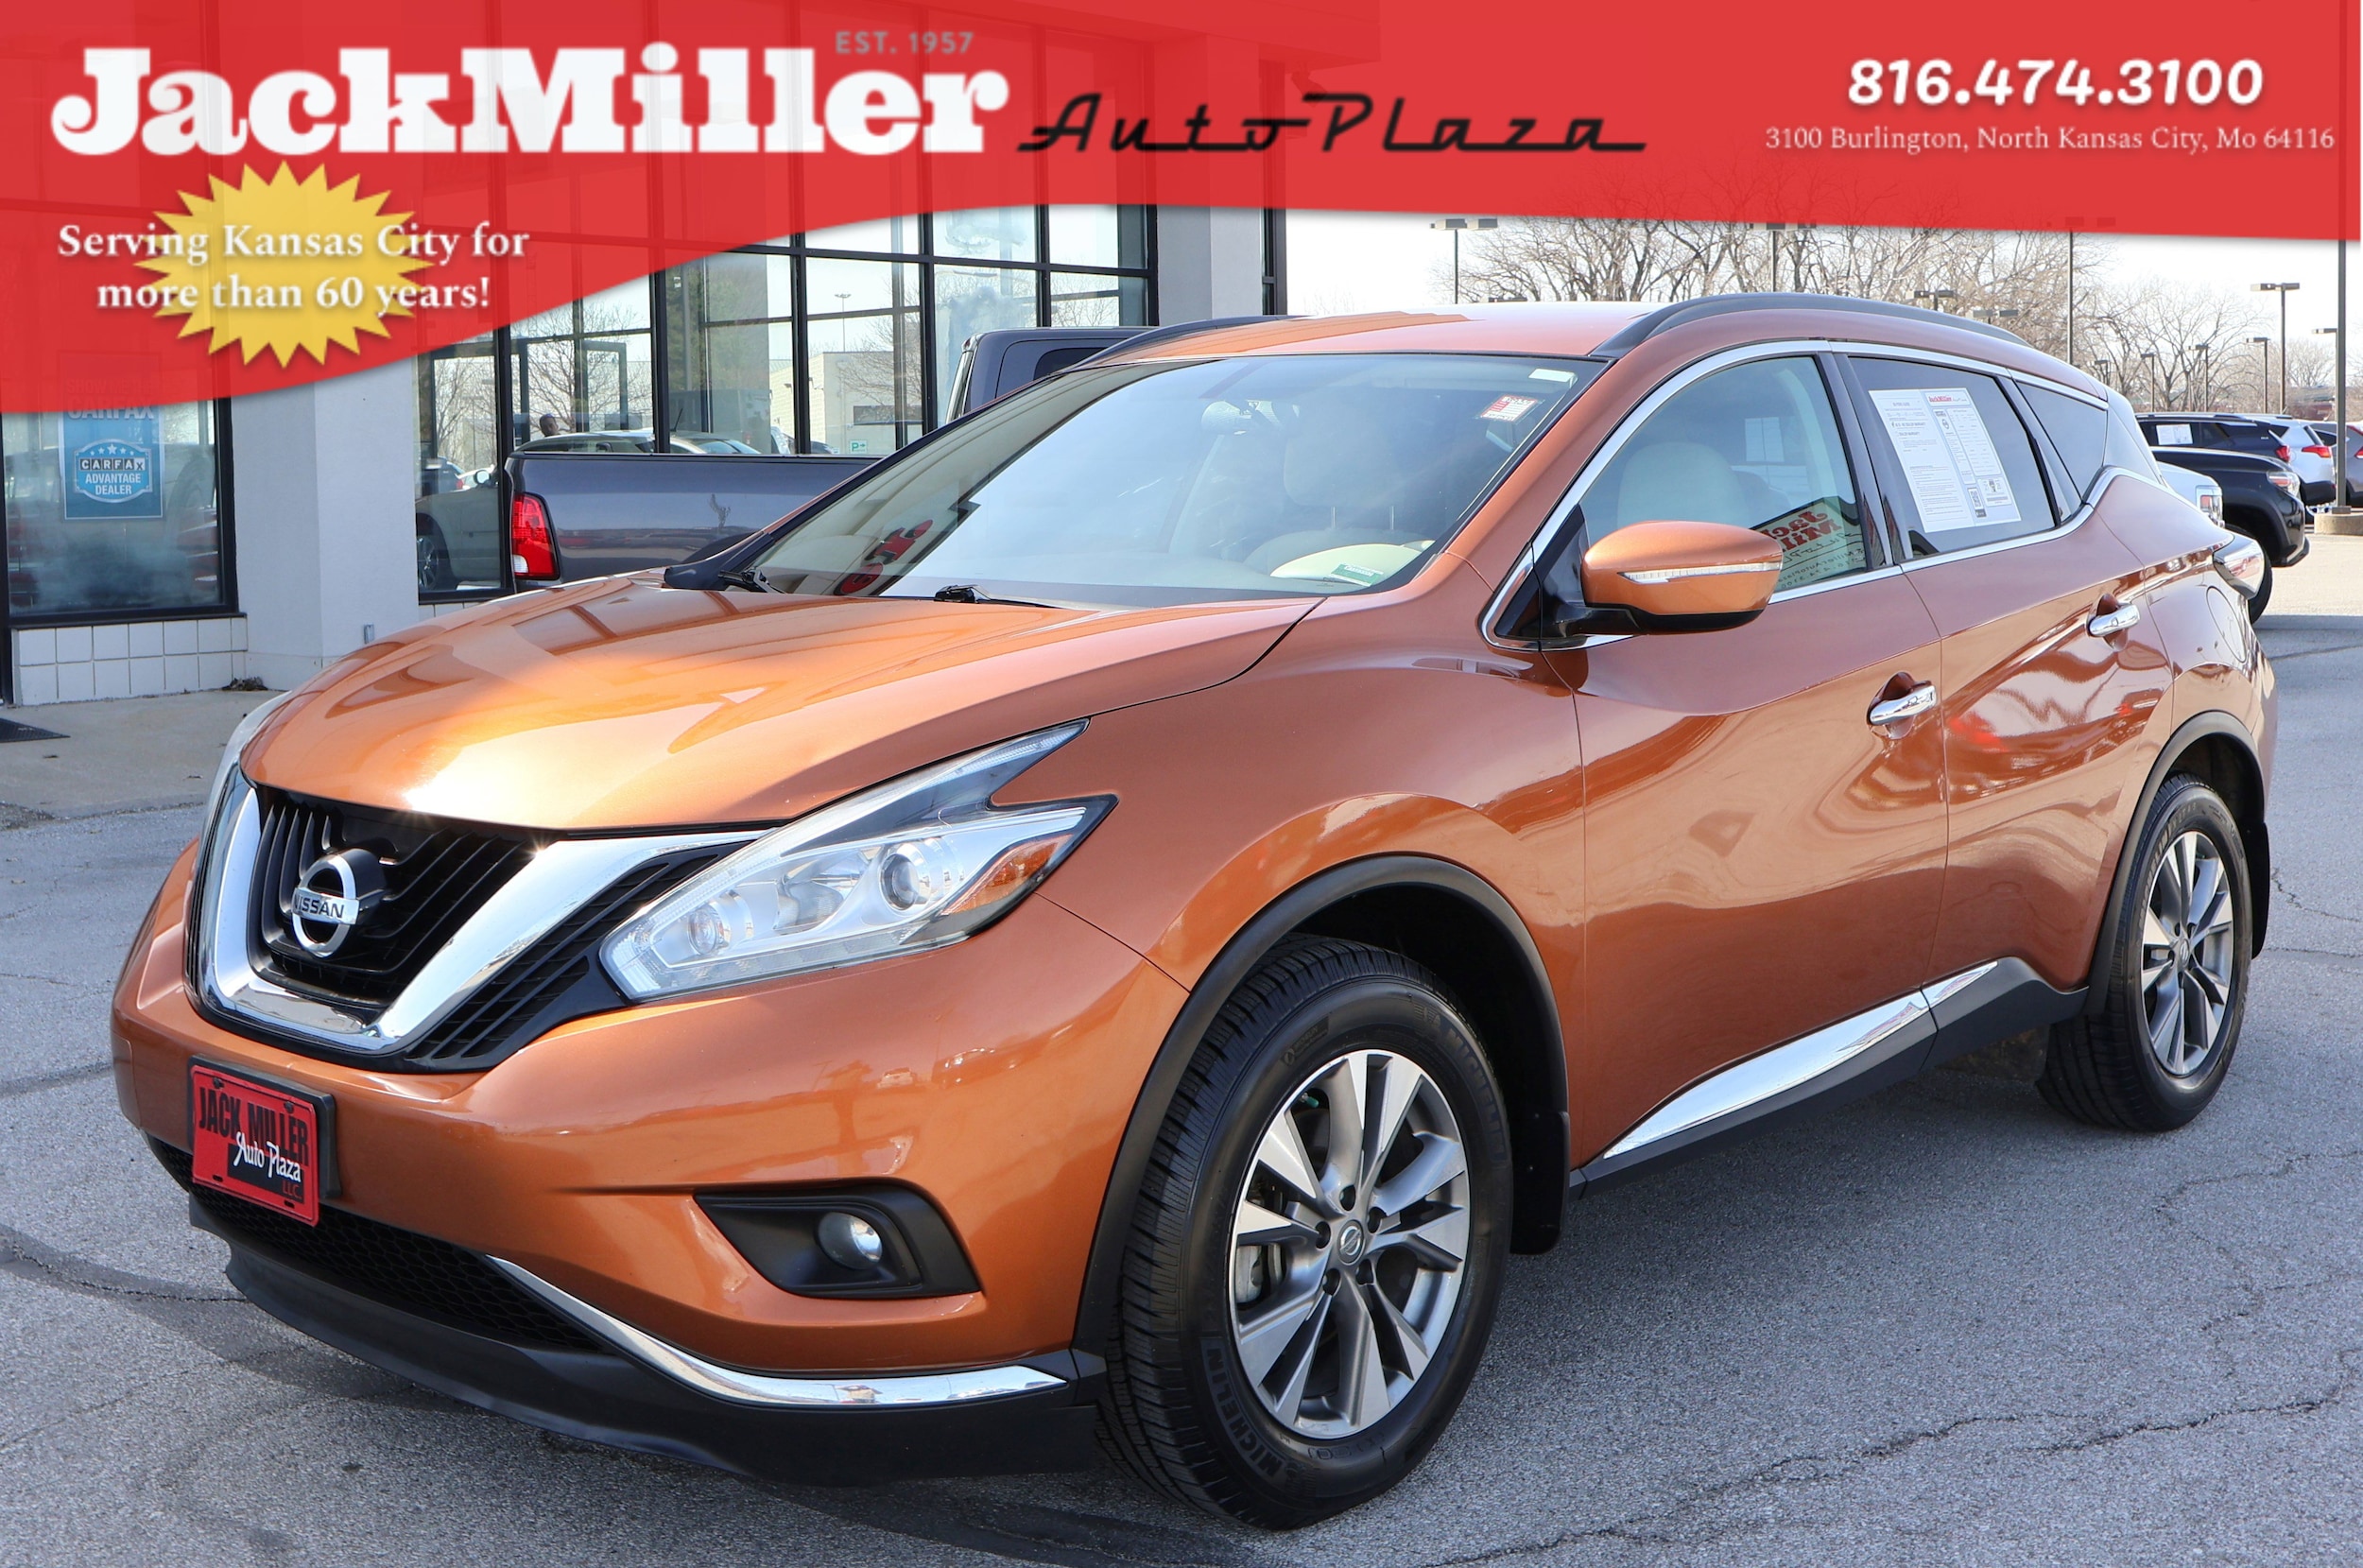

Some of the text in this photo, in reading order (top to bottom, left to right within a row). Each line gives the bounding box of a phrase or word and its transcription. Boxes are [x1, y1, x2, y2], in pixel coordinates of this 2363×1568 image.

[80, 457, 146, 471] CARFAX
[84, 473, 142, 485] ADVANTAGE
[95, 484, 133, 495] DEALER
[293, 892, 345, 919] NISSAN
[198, 1086, 310, 1168] JACK MILLER
[233, 1130, 302, 1183] Auto Plaza
[1205, 1348, 1285, 1478] MICHELIN
